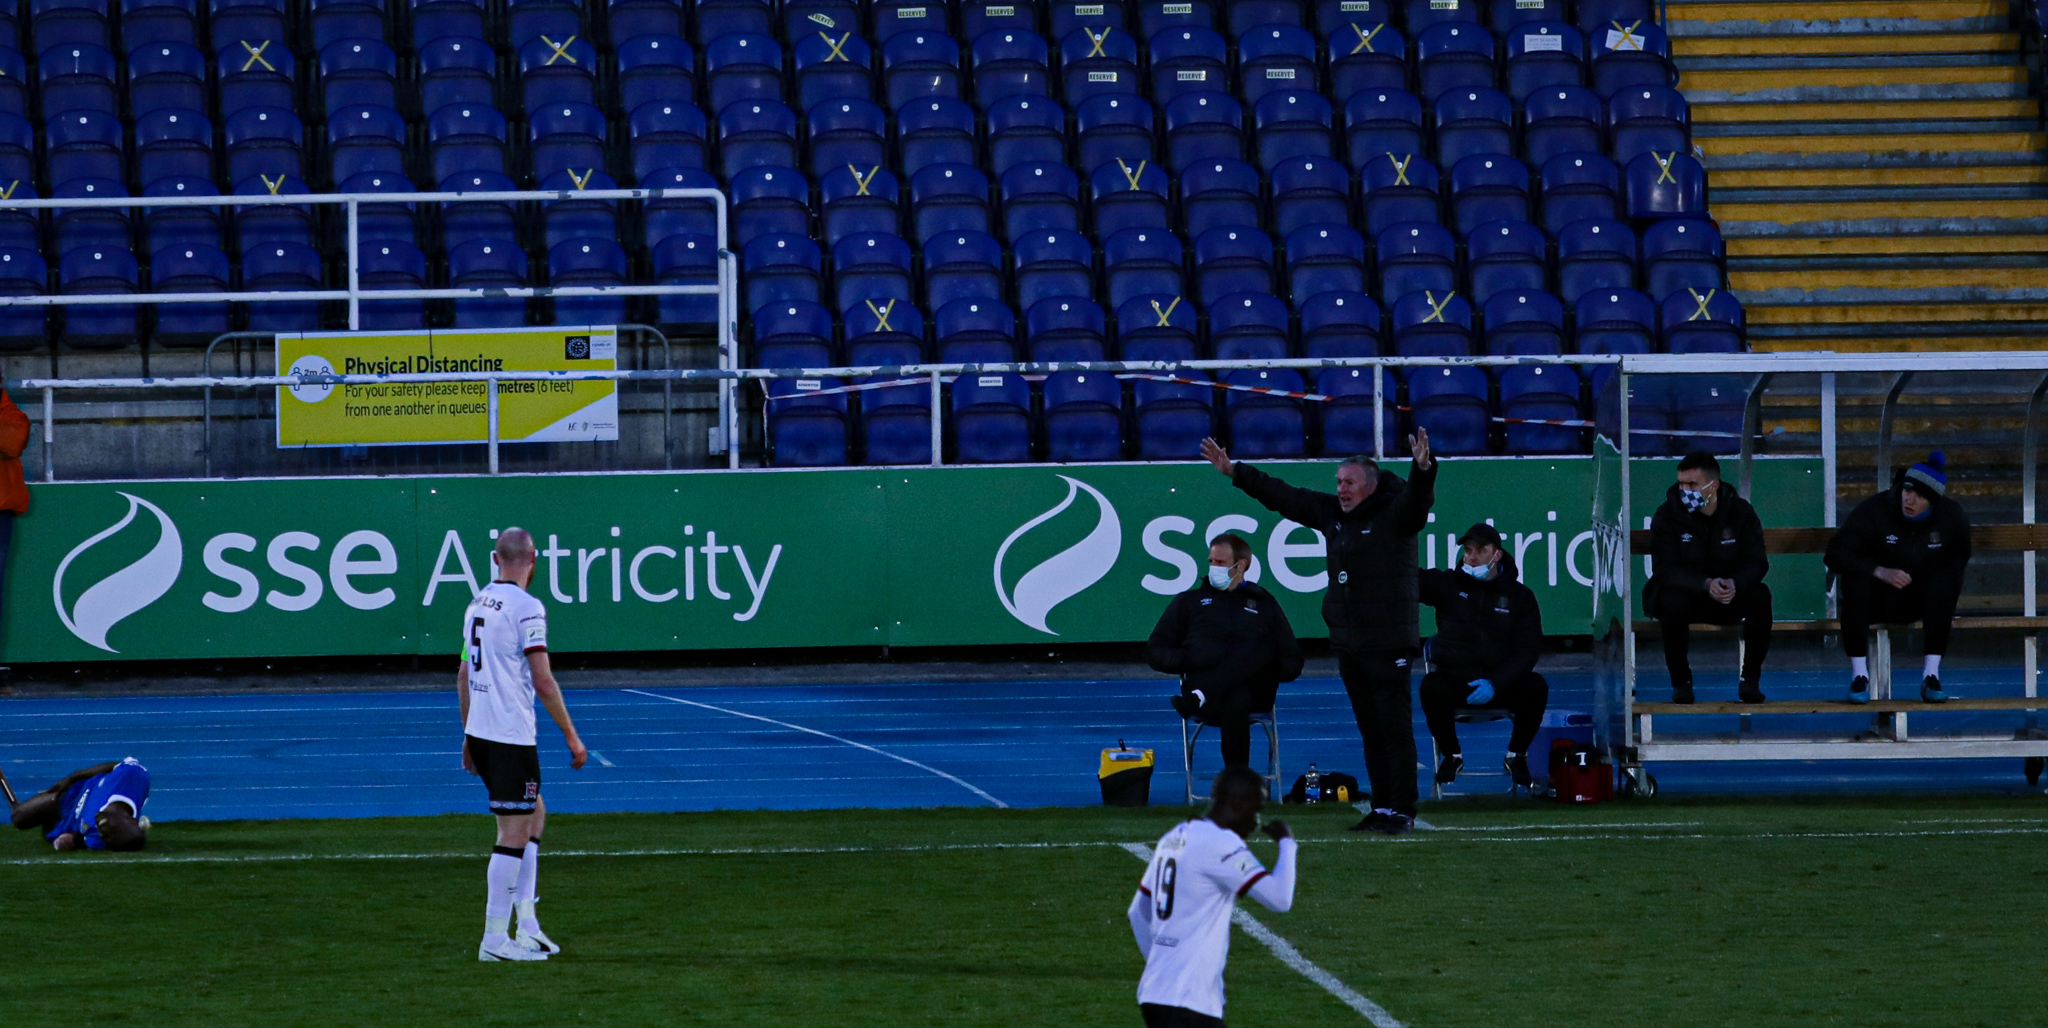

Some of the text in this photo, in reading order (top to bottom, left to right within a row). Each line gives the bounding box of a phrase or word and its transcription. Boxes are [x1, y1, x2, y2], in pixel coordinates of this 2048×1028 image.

[898, 9, 926, 17] RESERVED
[986, 7, 1015, 16] RESERVED
[304, 368, 318, 376] 2m
[345, 354, 504, 374] Physical Distancing
[344, 383, 362, 397] For
[364, 385, 389, 398] your
[391, 381, 423, 397] safety
[425, 382, 457, 397] please
[460, 380, 486, 397] keep
[344, 401, 487, 417] from one another in queues
[1141, 513, 1330, 596] sse
[201, 525, 783, 623] sse Aitricity
[471, 616, 485, 672] 5
[1155, 857, 1176, 921] 19
